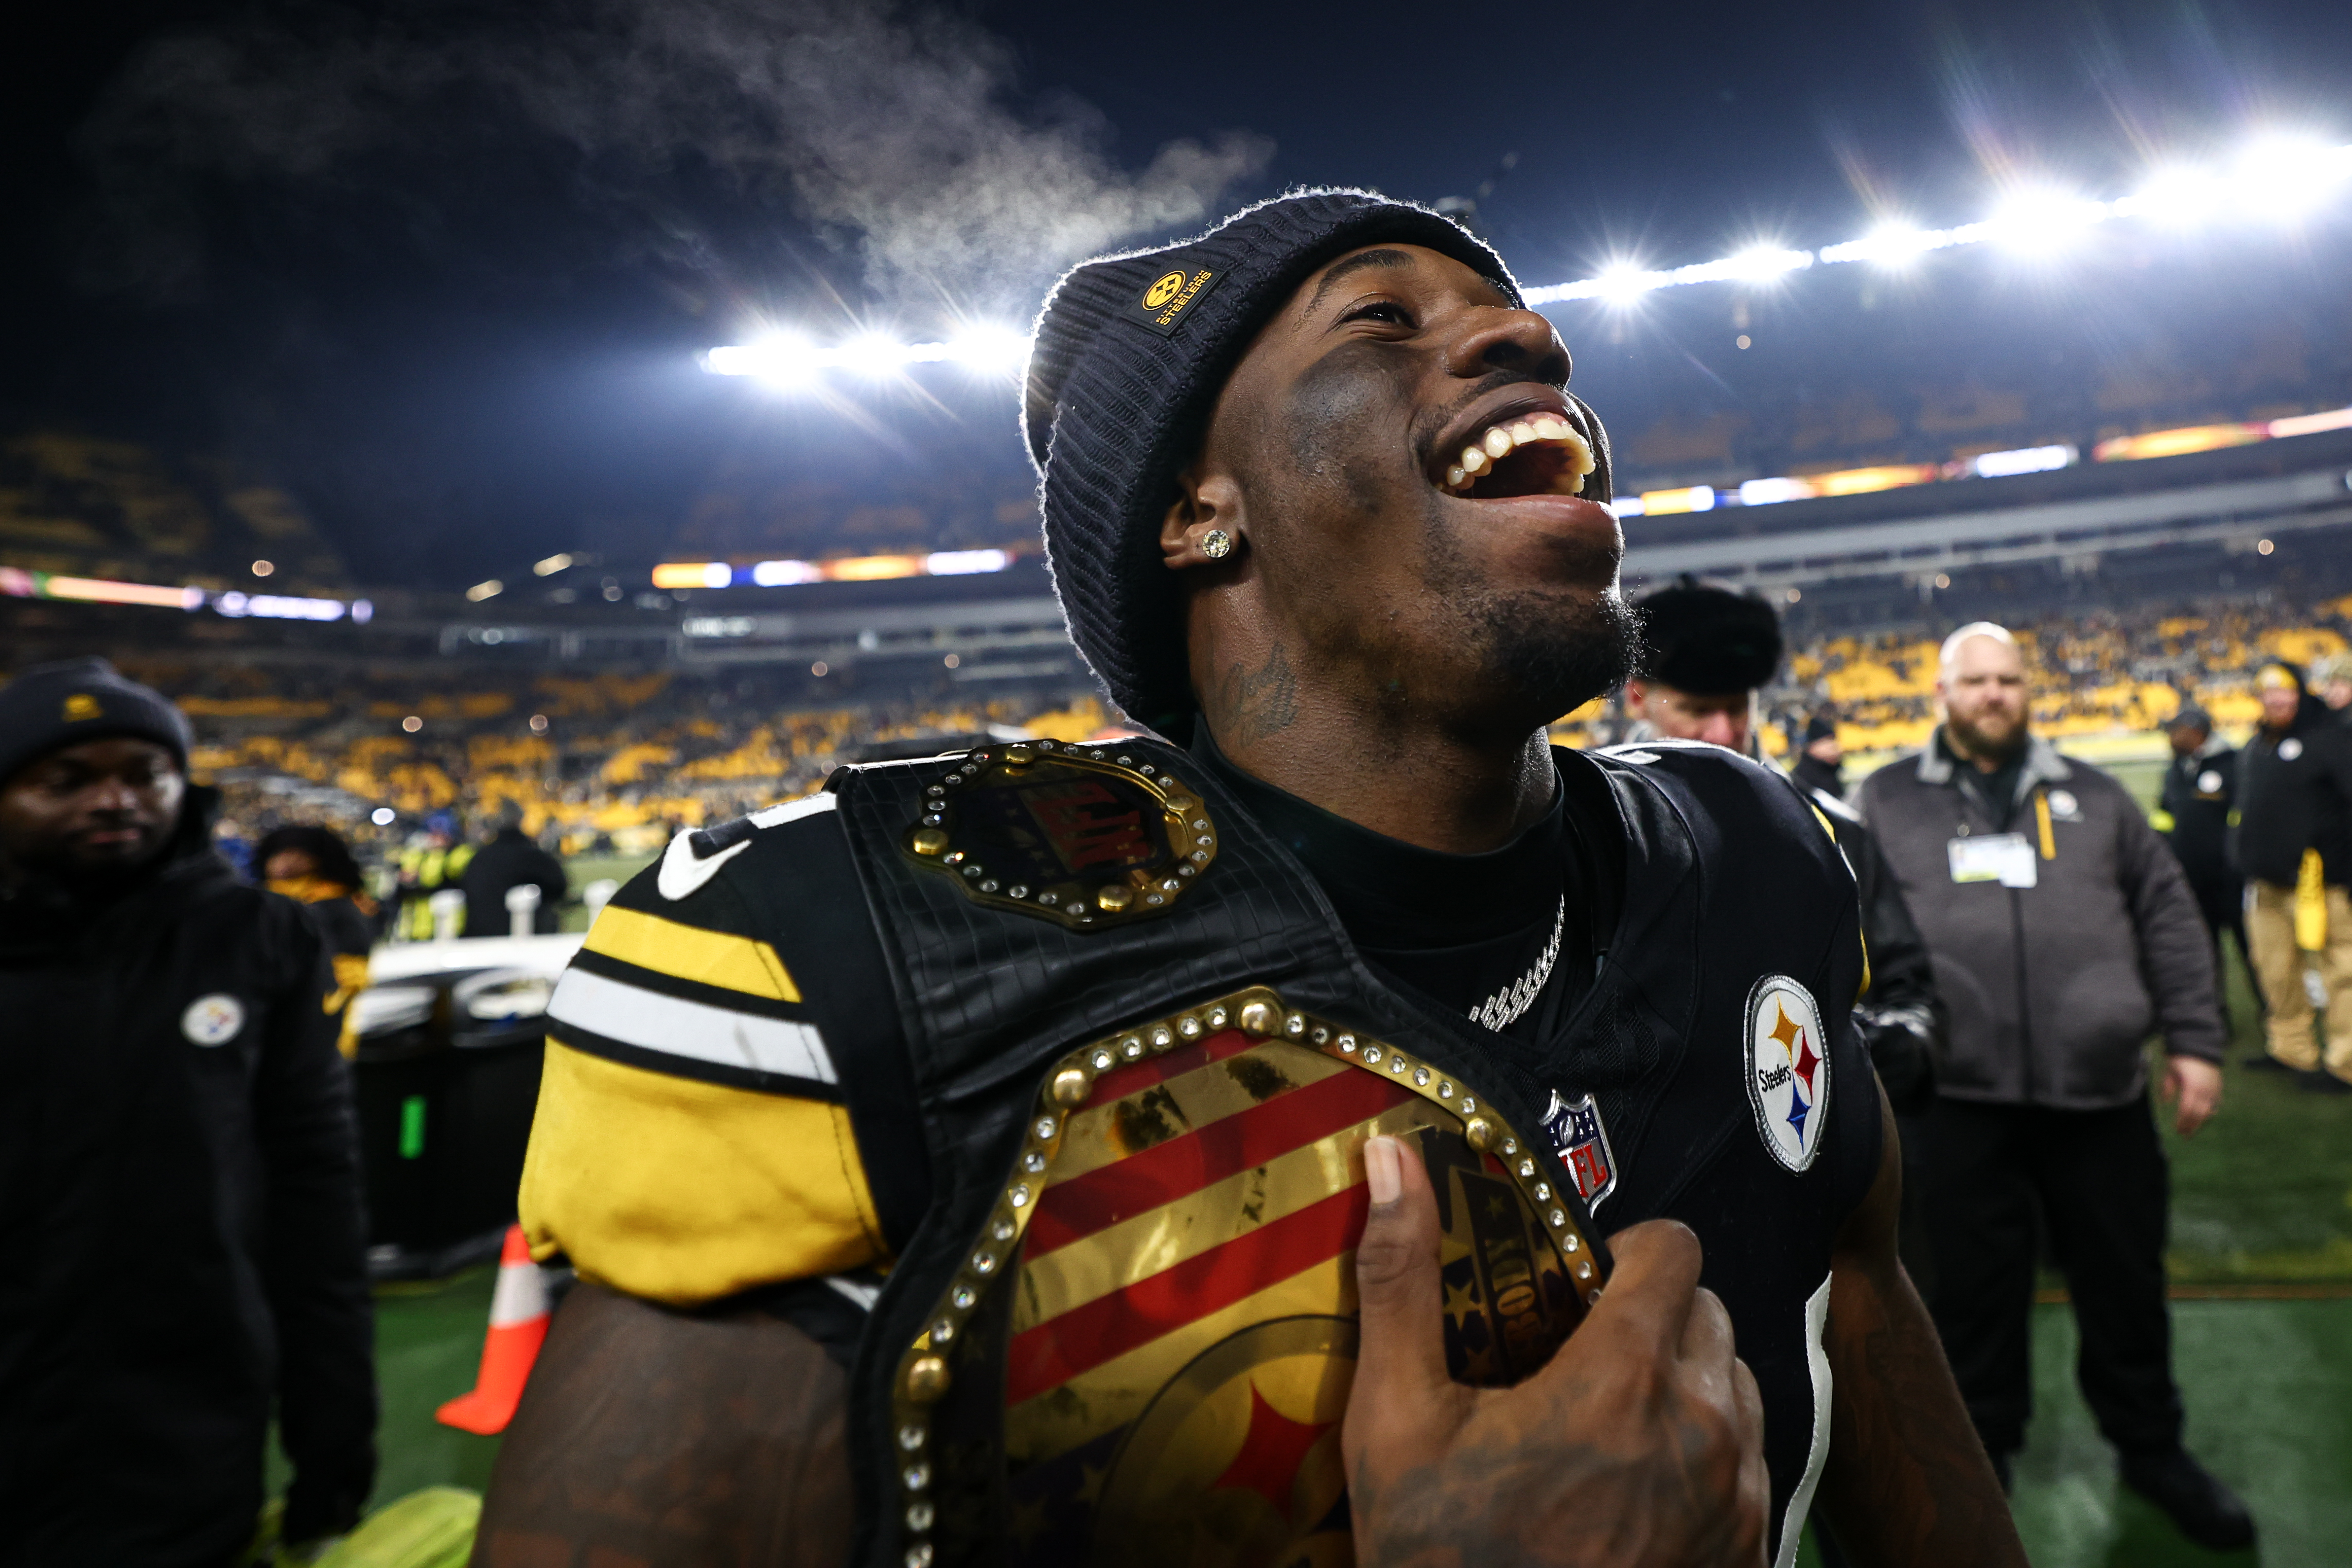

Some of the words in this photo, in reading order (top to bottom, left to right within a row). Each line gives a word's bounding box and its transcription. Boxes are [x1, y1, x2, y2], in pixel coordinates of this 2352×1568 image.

[1160, 272, 1213, 325] STEELERS
[1032, 781, 1151, 870] NFL
[1759, 1063, 1792, 1093] Steelers
